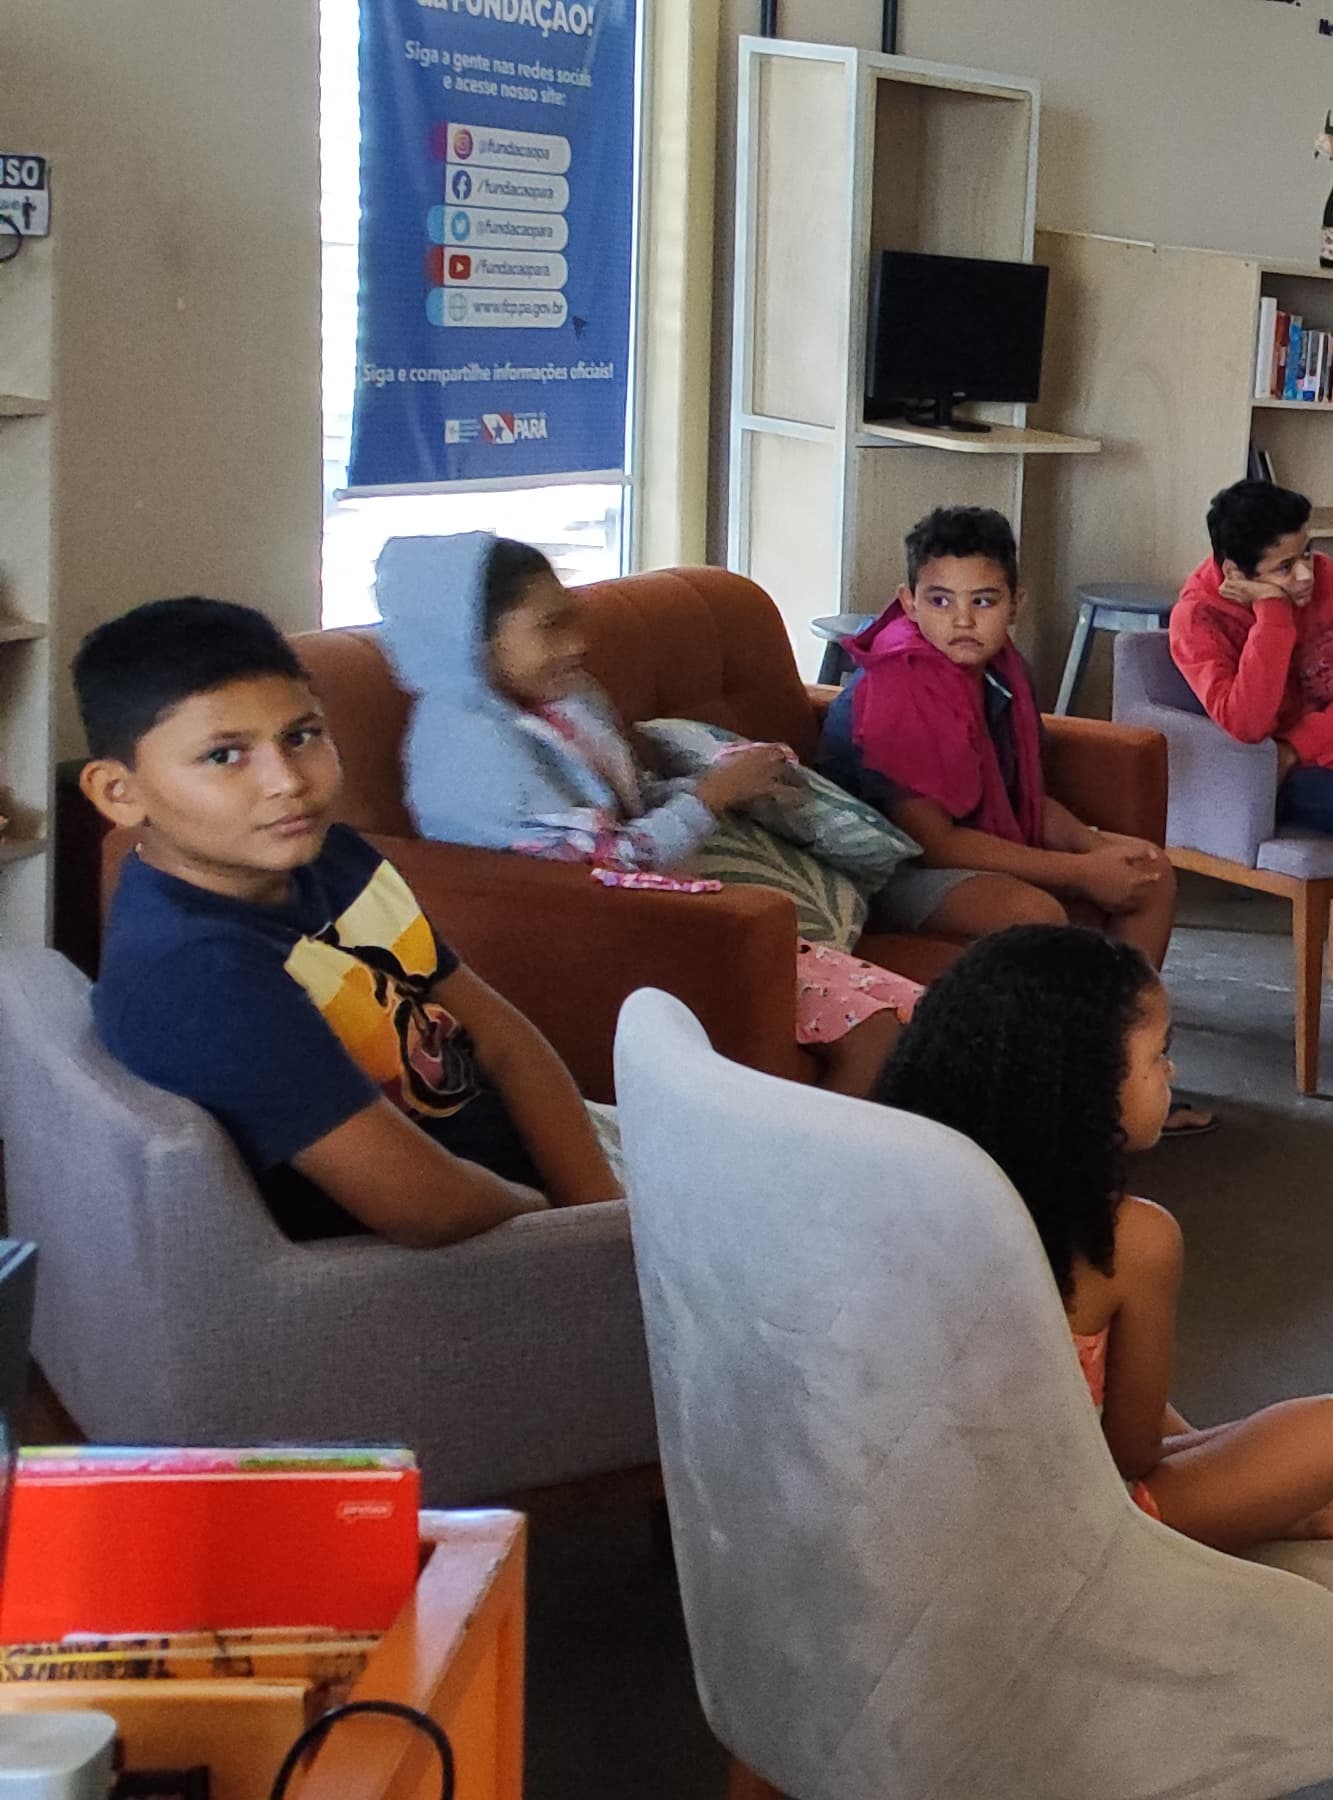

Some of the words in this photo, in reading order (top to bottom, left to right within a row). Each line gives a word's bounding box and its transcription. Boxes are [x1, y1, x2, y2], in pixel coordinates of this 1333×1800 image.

[405, 39, 438, 67] Siga
[442, 51, 450, 65] a
[453, 51, 490, 72] gente
[493, 59, 515, 75] nas
[518, 60, 554, 81] redes
[557, 68, 593, 88] sociais
[442, 75, 453, 89] e
[455, 76, 498, 96] acesse
[500, 83, 537, 102] nosso
[541, 86, 566, 106] site:
[363, 363, 395, 387] Siga
[398, 368, 406, 381] e
[409, 363, 490, 386] compartilhe
[493, 362, 567, 384] informações
